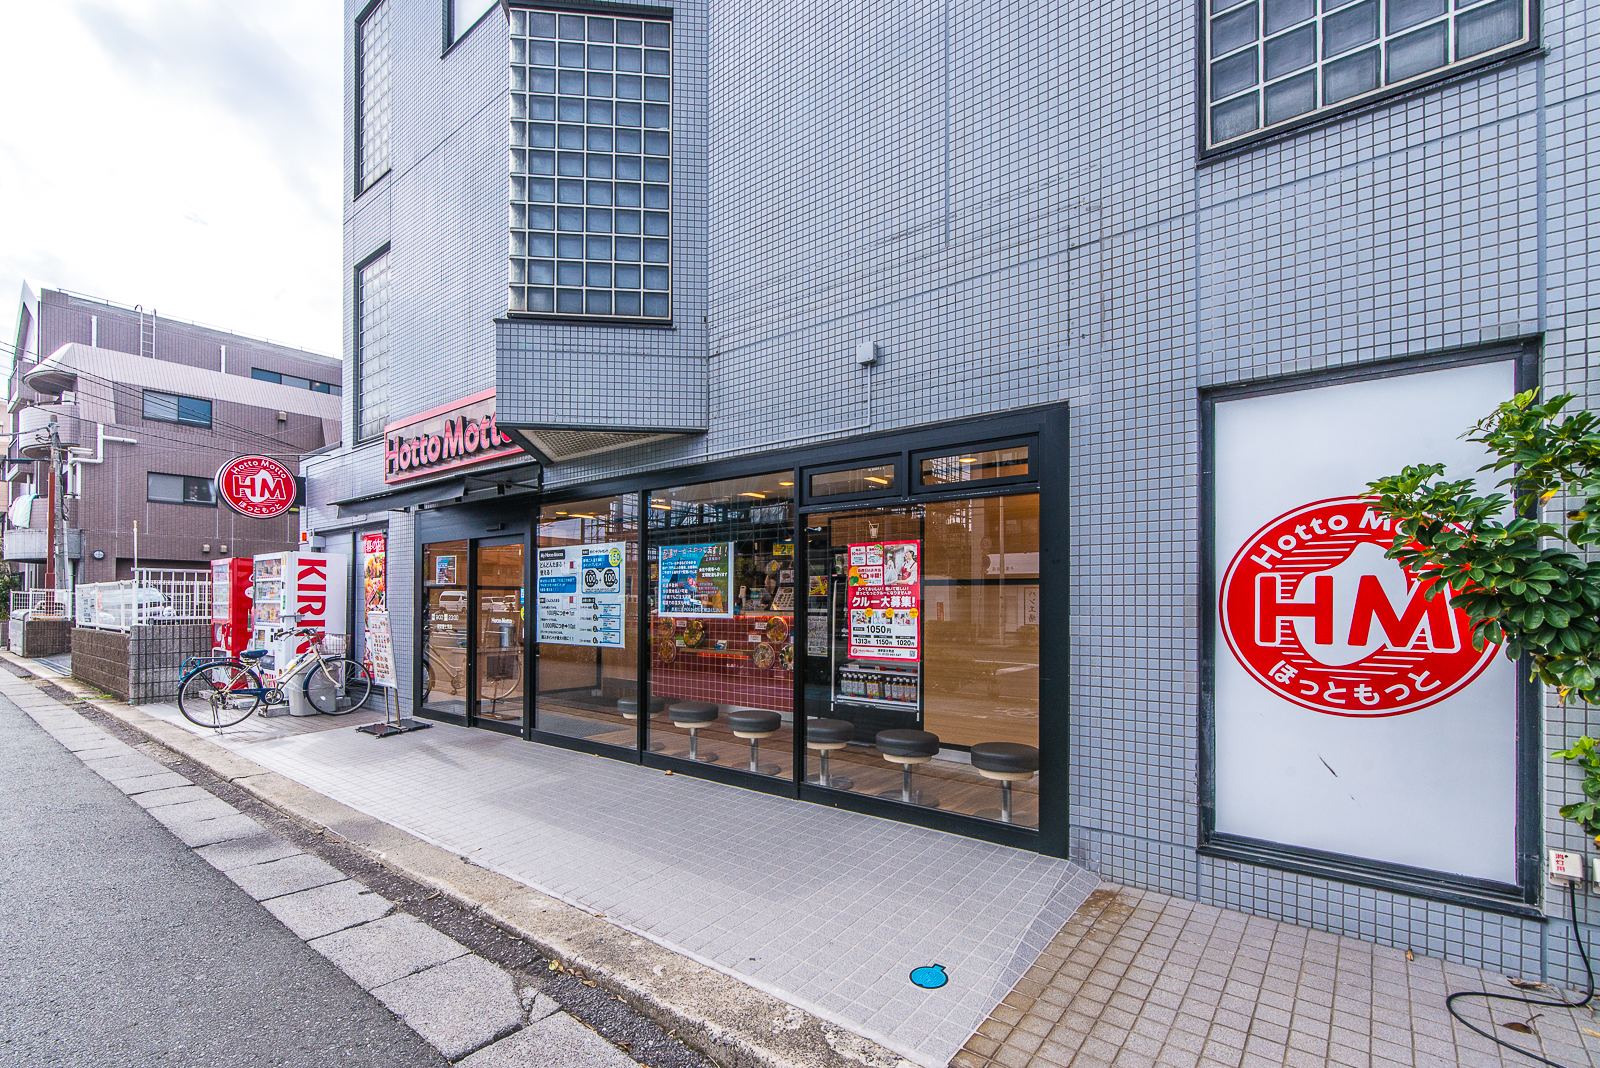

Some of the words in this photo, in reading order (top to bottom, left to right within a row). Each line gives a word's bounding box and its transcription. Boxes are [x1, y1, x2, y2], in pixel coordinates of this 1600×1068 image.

[230, 460, 259, 475] Hotto
[260, 460, 287, 479] Motto
[385, 433, 441, 474] Hotto
[233, 474, 287, 500] HM
[238, 500, 283, 514] ほっともっと
[1249, 513, 1349, 570] Hotto
[1254, 571, 1462, 654] HM
[1267, 659, 1442, 706] ほっともっと
